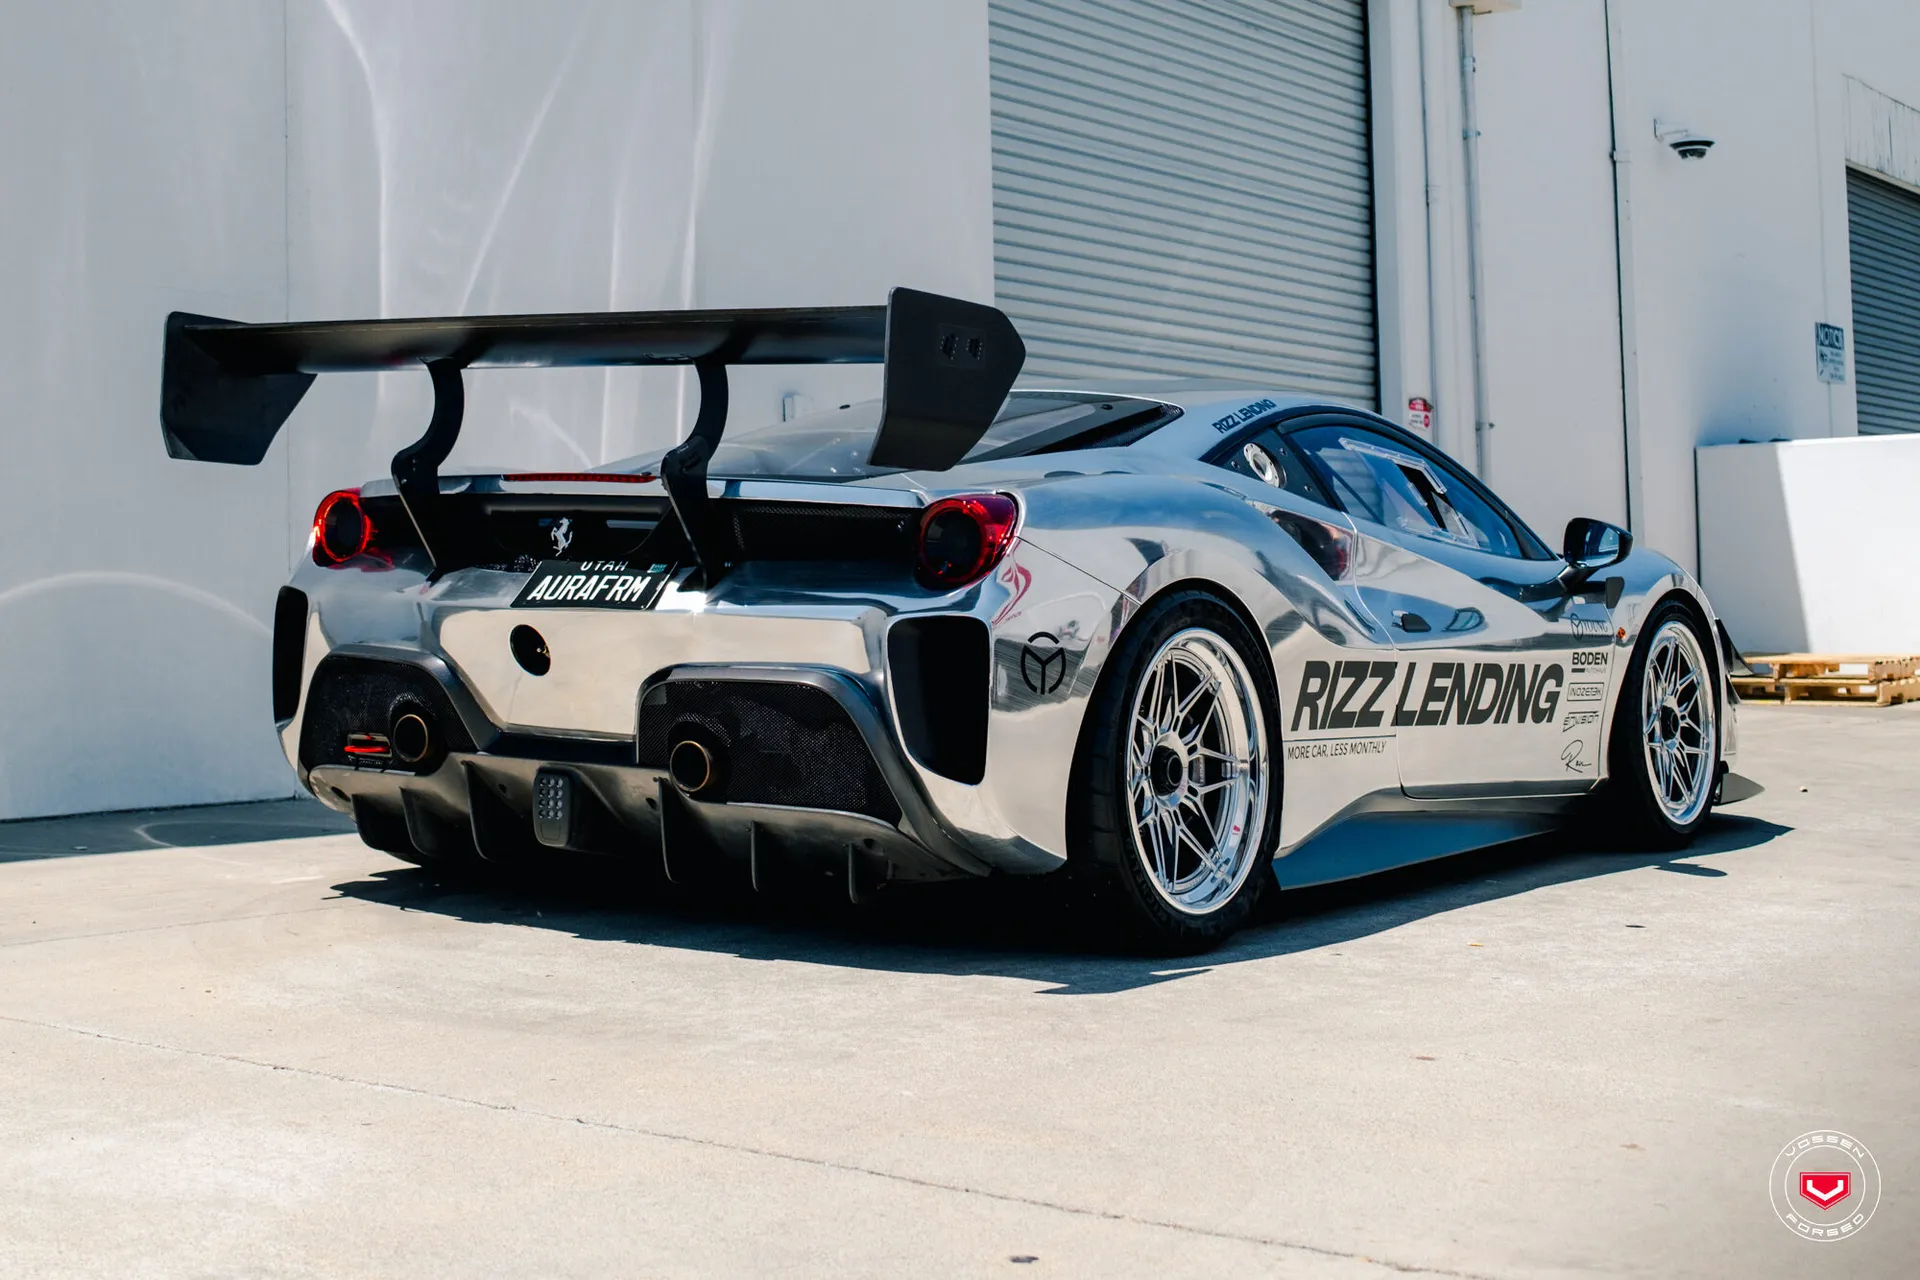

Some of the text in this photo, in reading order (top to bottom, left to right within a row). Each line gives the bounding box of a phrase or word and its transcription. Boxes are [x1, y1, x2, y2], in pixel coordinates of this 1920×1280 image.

[1211, 398, 1277, 434] RIZZ LENDING
[580, 560, 629, 571] UTAH
[527, 575, 651, 602] AURAFRM
[1572, 651, 1609, 665] BODEN
[1290, 660, 1398, 732] RIZZ
[1390, 661, 1565, 727] LENDING
[1287, 740, 1387, 760] MORE CAR, LESS MONTHLY
